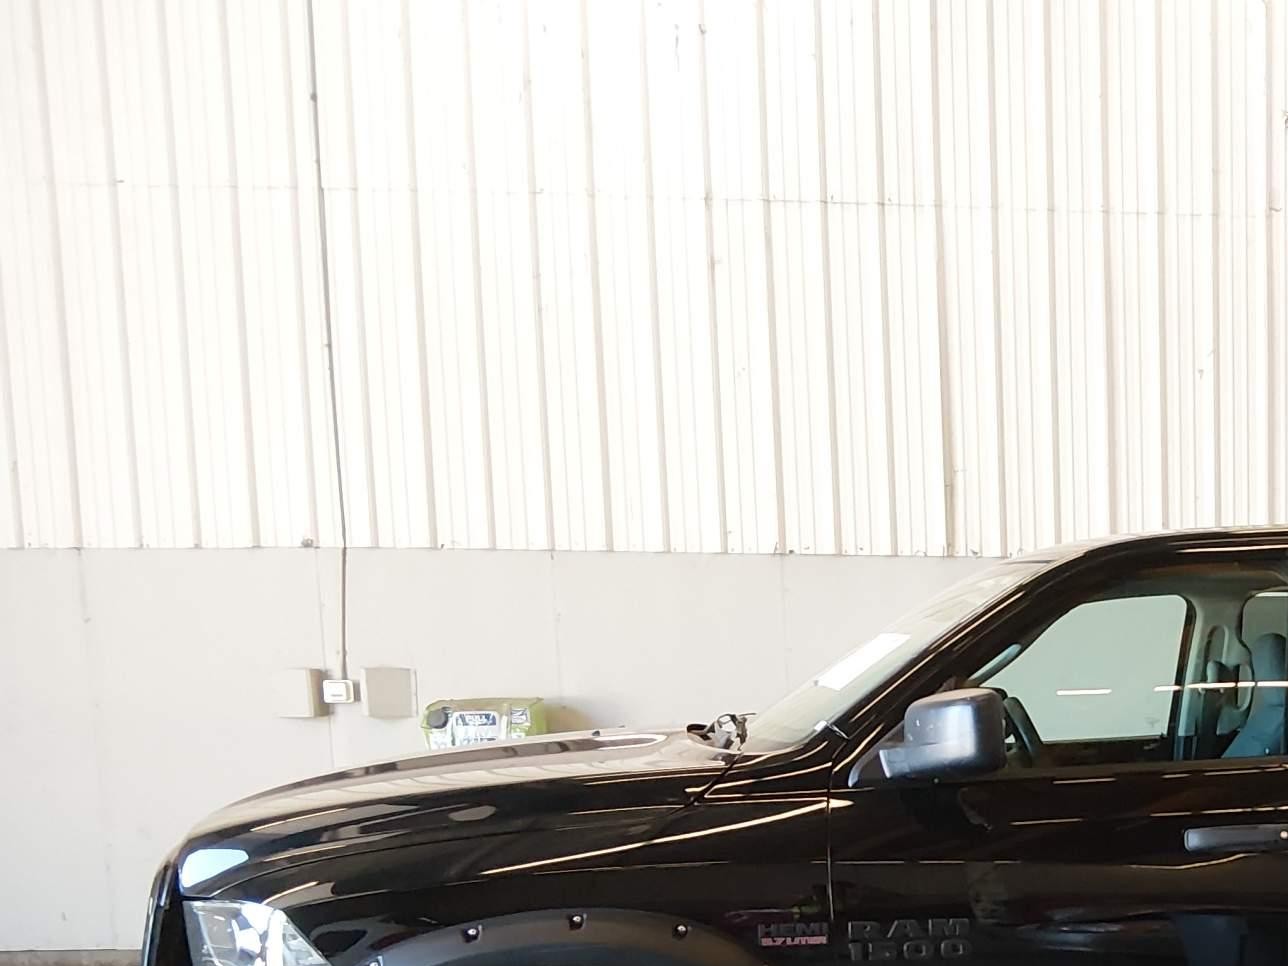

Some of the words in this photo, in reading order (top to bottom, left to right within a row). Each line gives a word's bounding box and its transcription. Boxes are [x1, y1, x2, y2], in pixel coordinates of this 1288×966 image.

[758, 922, 829, 937] HEMI
[847, 918, 971, 939] RAM
[847, 938, 973, 960] 1500
